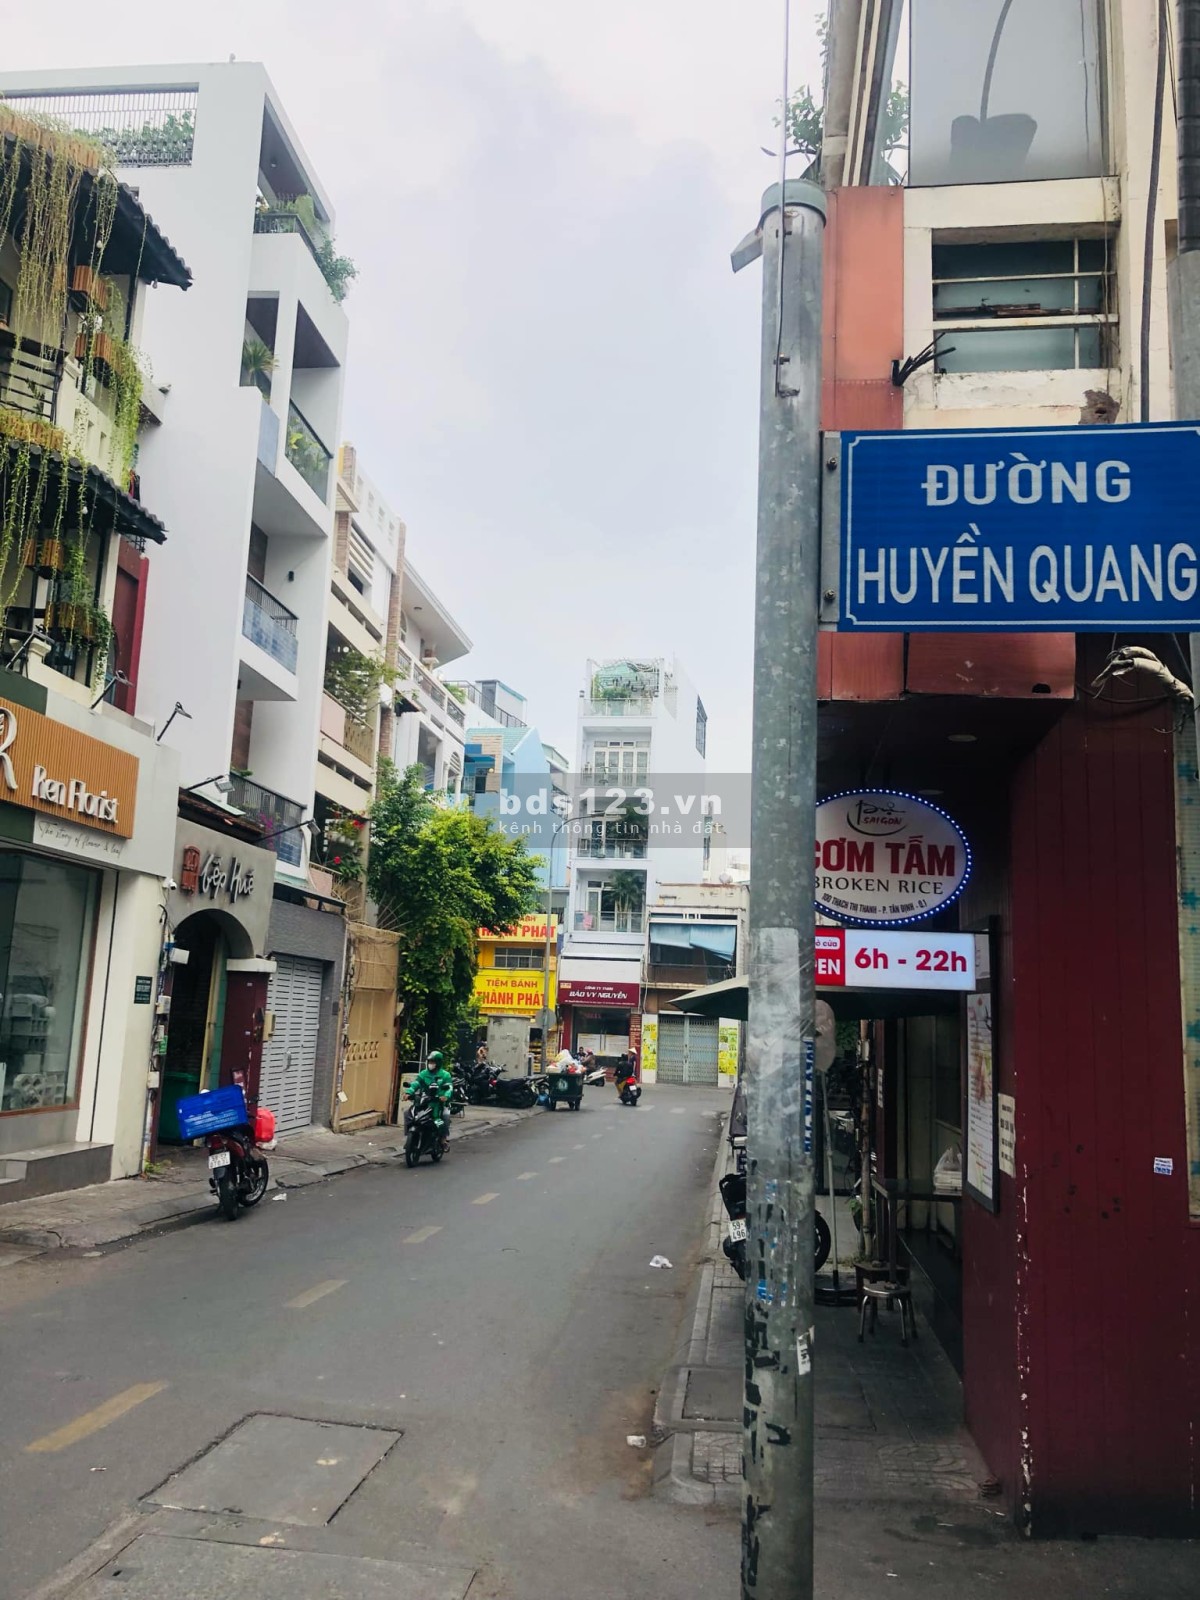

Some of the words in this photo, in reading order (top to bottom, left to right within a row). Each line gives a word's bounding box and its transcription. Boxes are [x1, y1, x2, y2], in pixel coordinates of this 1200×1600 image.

[921, 453, 1131, 506] ĐƯỜNG
[858, 523, 1014, 604] HUYỀN
[1029, 543, 1198, 604] QUANG
[32, 764, 66, 806] Ren
[67, 778, 119, 824] Florist
[815, 837, 874, 873] ƠM
[898, 880, 943, 894] RICE
[854, 948, 889, 970] 6h
[915, 949, 967, 972] 22h
[476, 989, 514, 1005] THÀNH
[511, 978, 538, 988] BÁNH
